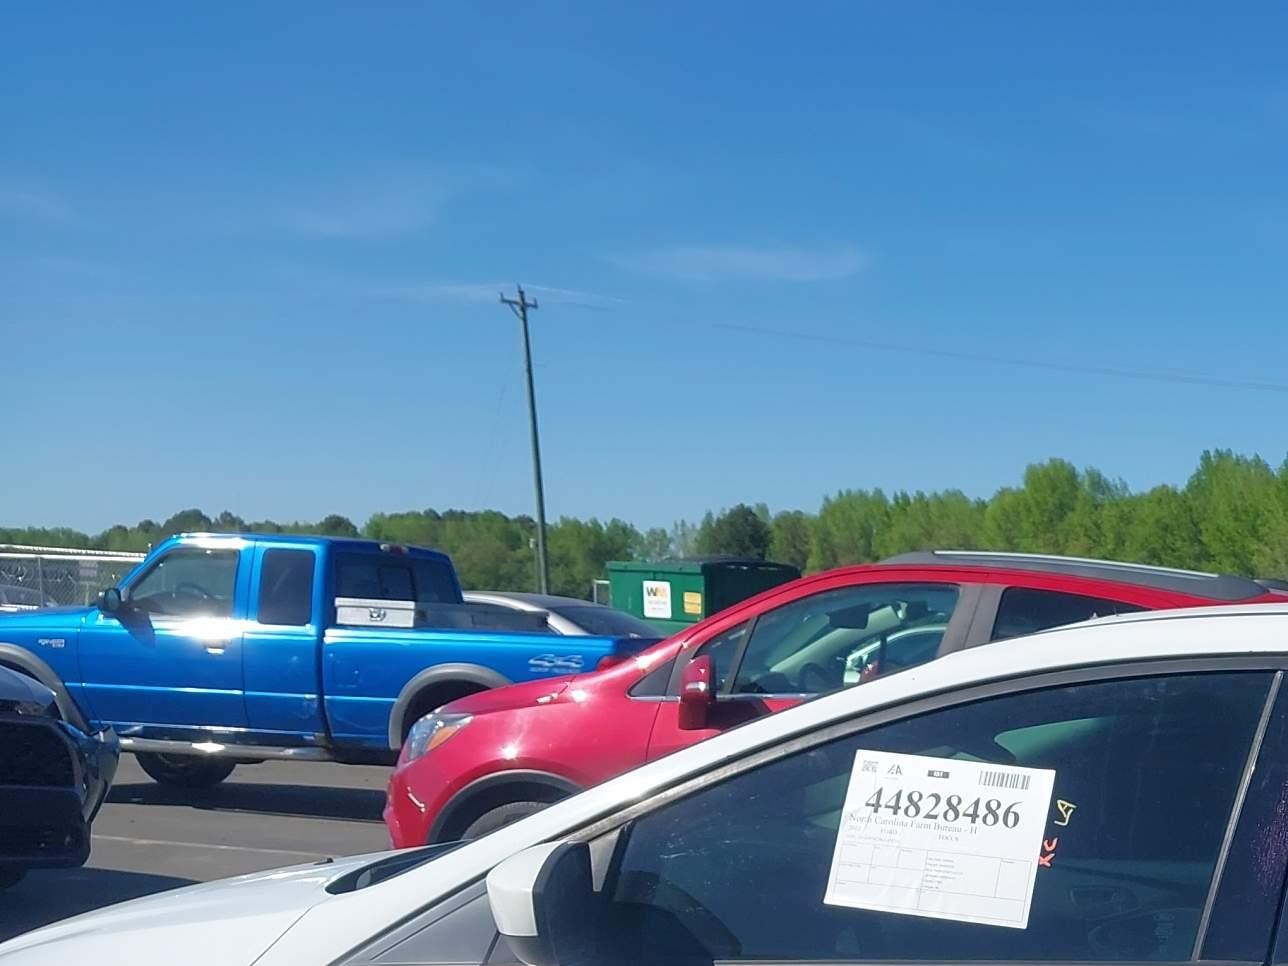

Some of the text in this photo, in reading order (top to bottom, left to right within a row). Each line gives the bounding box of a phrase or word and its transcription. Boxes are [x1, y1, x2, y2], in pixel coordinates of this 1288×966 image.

[848, 812, 872, 824] North
[874, 815, 908, 828] Carolina
[910, 820, 932, 831] Farm
[934, 821, 962, 833] Bureau
[865, 786, 1024, 829] 44828486
